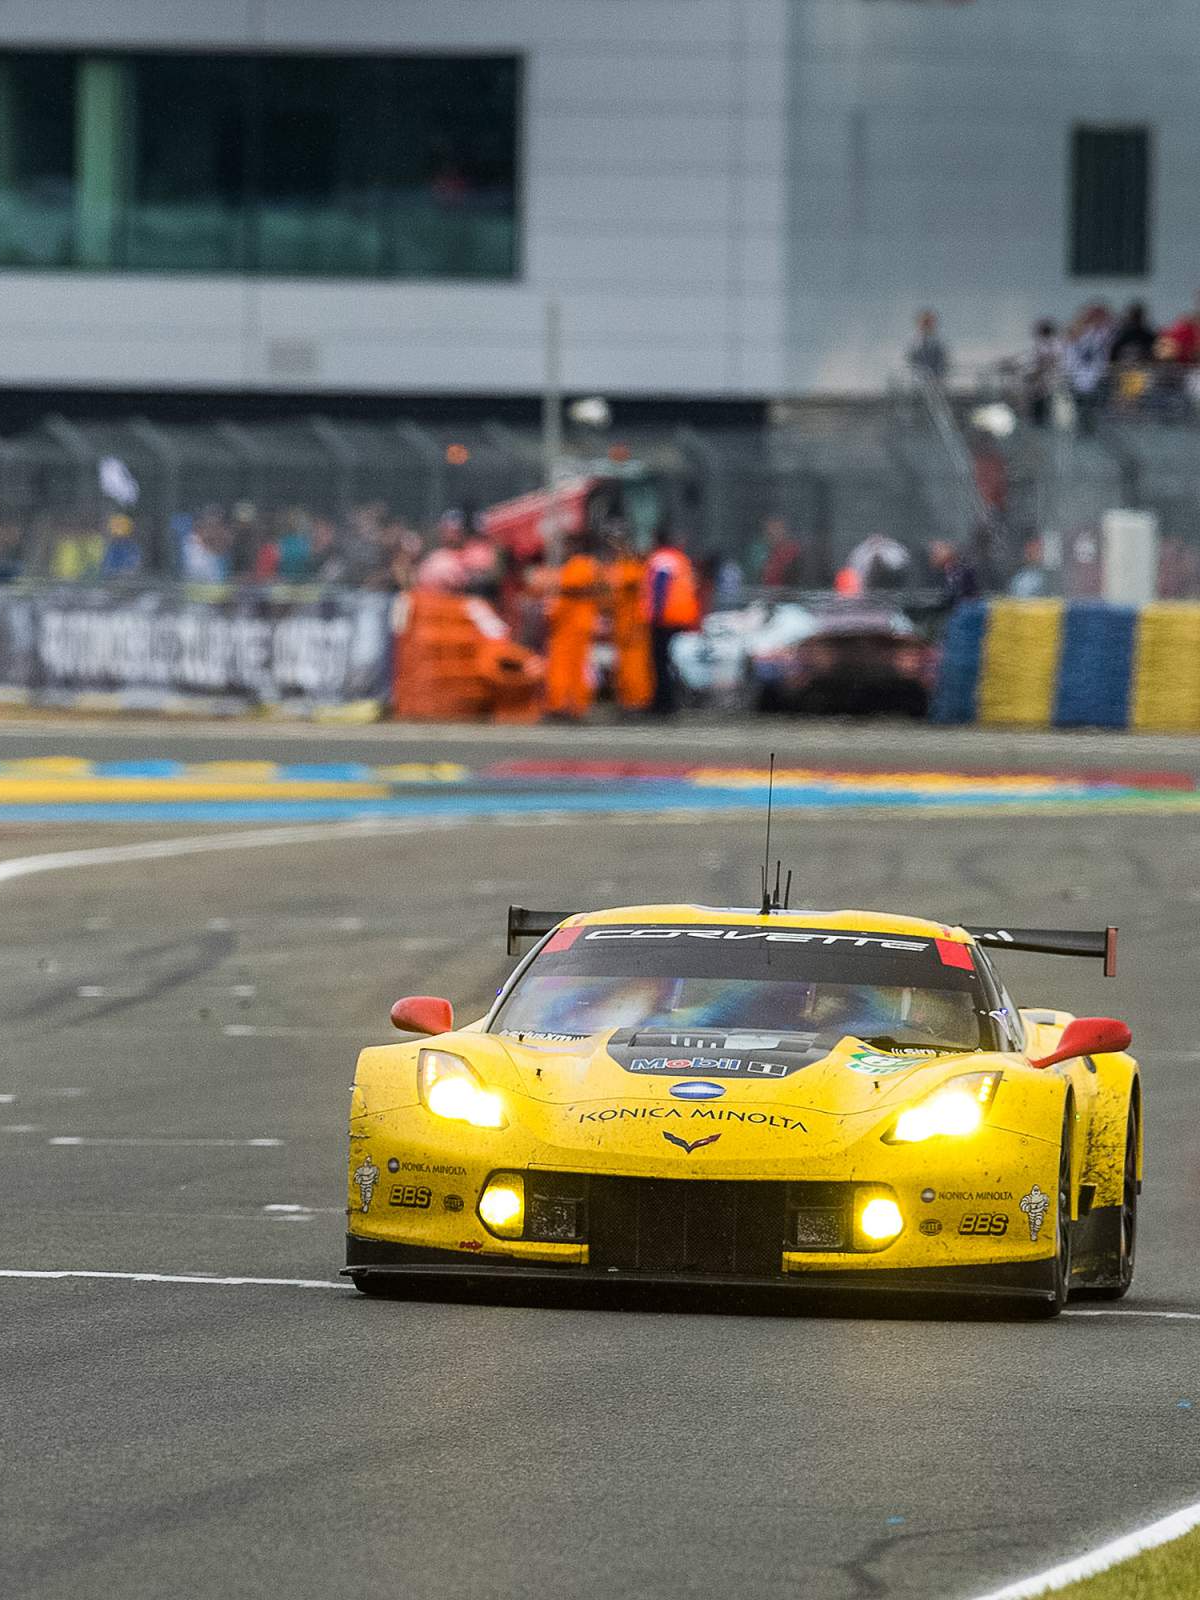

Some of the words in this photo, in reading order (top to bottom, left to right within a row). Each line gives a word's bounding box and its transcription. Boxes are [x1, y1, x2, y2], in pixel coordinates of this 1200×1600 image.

[584, 929, 930, 951] CORVETTE
[630, 1057, 742, 1071] Mobil
[579, 1107, 682, 1124] KONICA
[691, 1108, 809, 1134] MINOLTA
[402, 1161, 431, 1174] KONICA
[432, 1164, 467, 1176] MINOLTA
[389, 1184, 432, 1209] BBS
[939, 1191, 974, 1201] KONICA
[975, 1191, 1013, 1201] MINOLTA
[958, 1213, 1009, 1236] BBS
